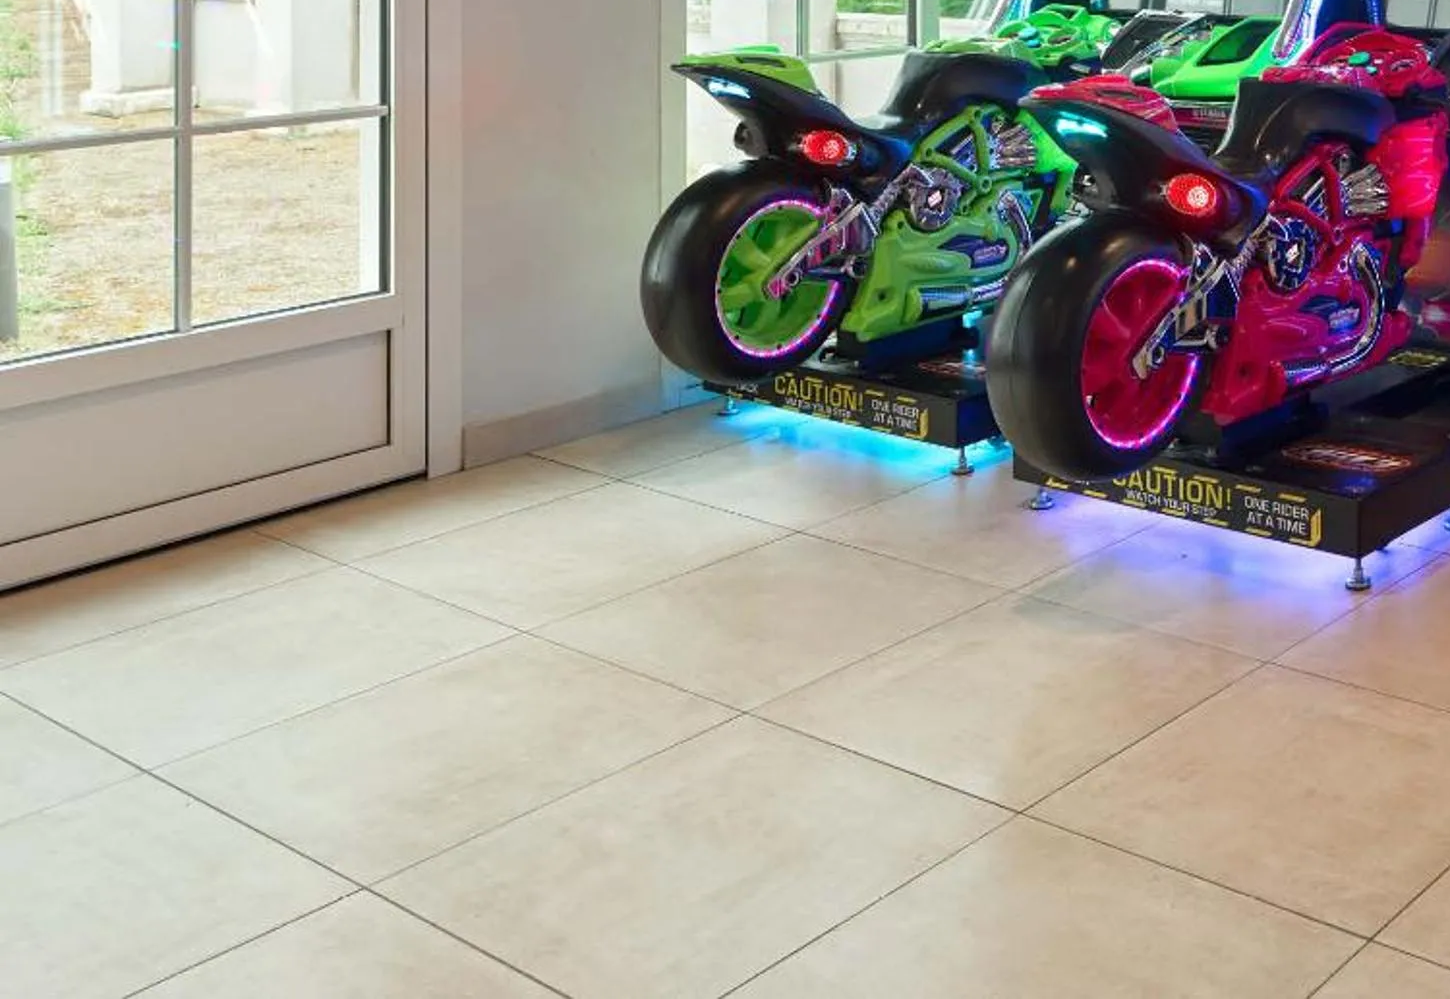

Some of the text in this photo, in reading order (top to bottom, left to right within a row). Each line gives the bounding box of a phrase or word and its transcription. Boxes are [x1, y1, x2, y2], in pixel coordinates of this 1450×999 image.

[775, 376, 864, 412] CAUTION!
[871, 399, 919, 419] ONE RIDER
[873, 413, 885, 424] AT
[1125, 488, 1162, 507] WATCH
[1244, 495, 1310, 521] ONE RIDER
[1247, 511, 1308, 536] AT A TIME
